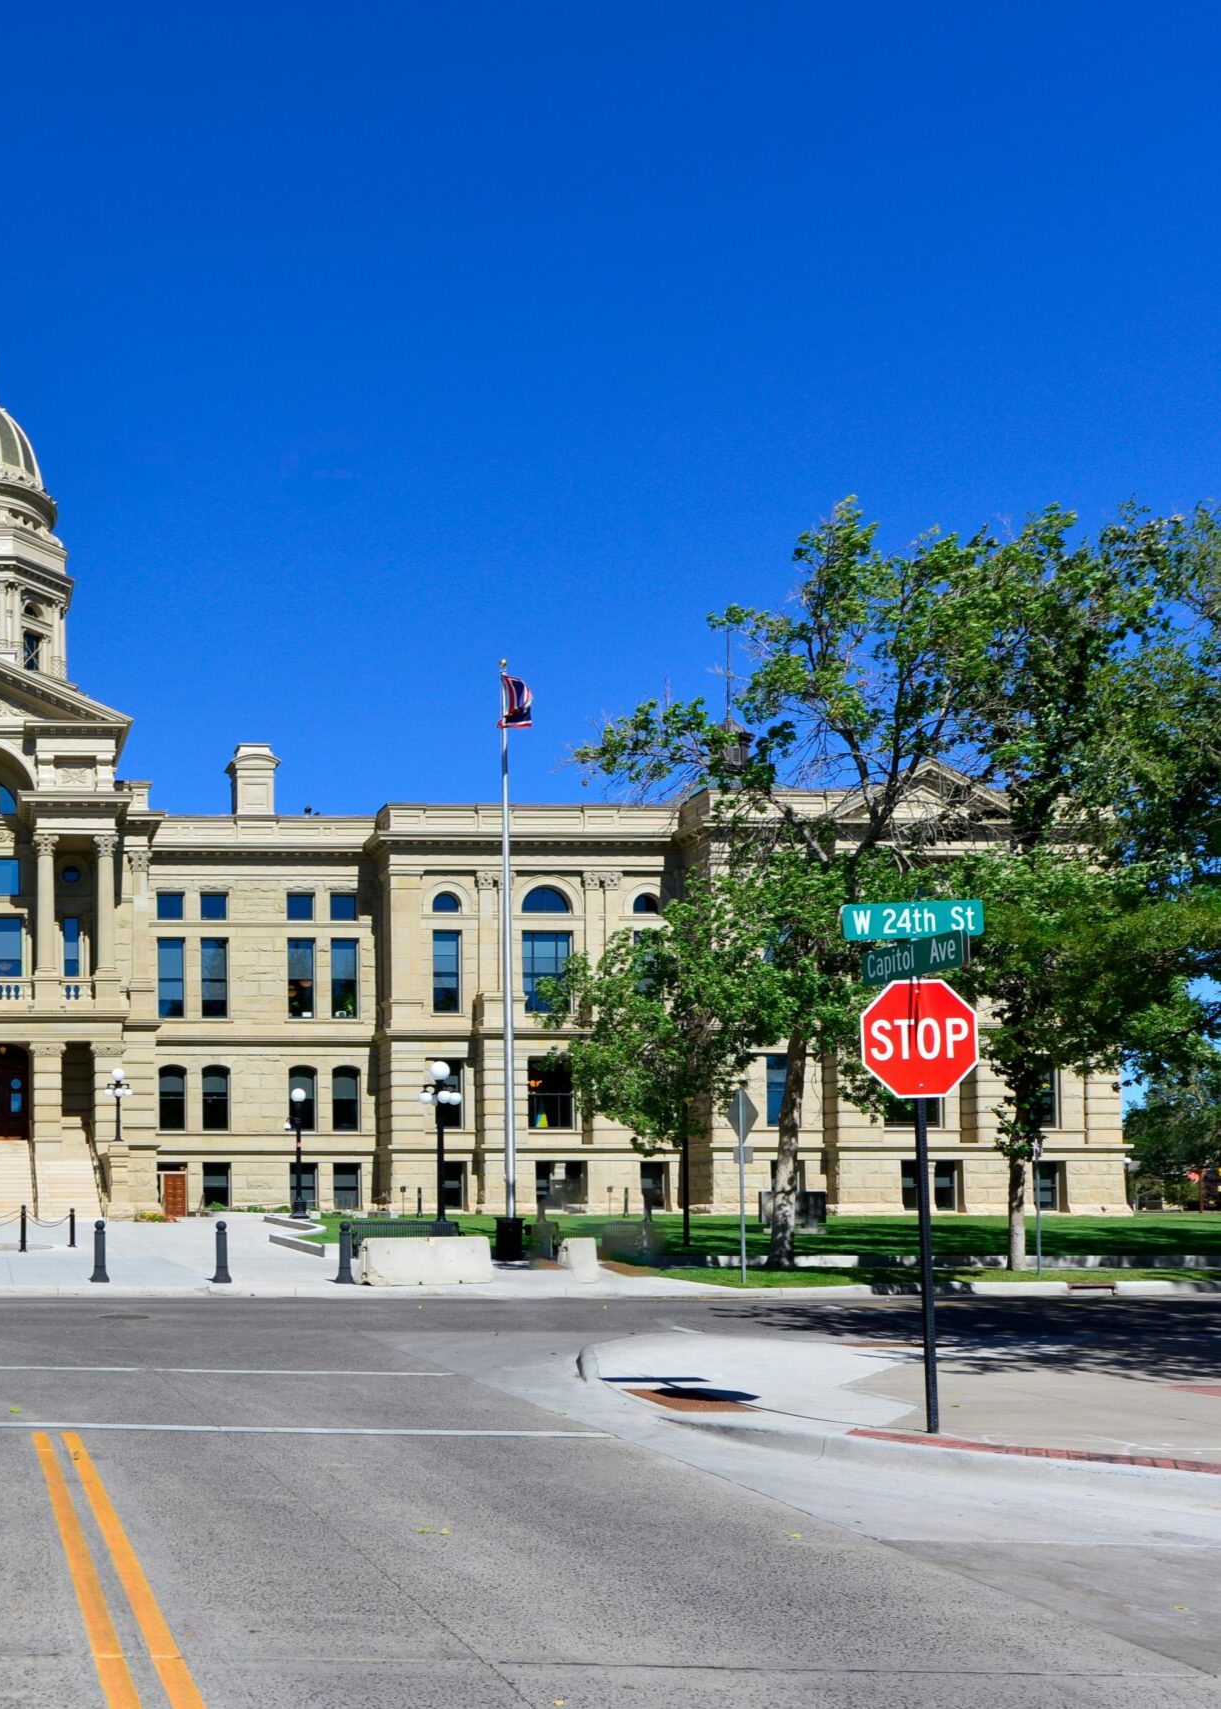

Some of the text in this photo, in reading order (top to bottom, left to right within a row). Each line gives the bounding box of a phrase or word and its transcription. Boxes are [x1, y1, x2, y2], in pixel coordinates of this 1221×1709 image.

[852, 905, 976, 935] W 24th St
[867, 937, 956, 979] Capitol Ave
[870, 1017, 969, 1062] STOP
